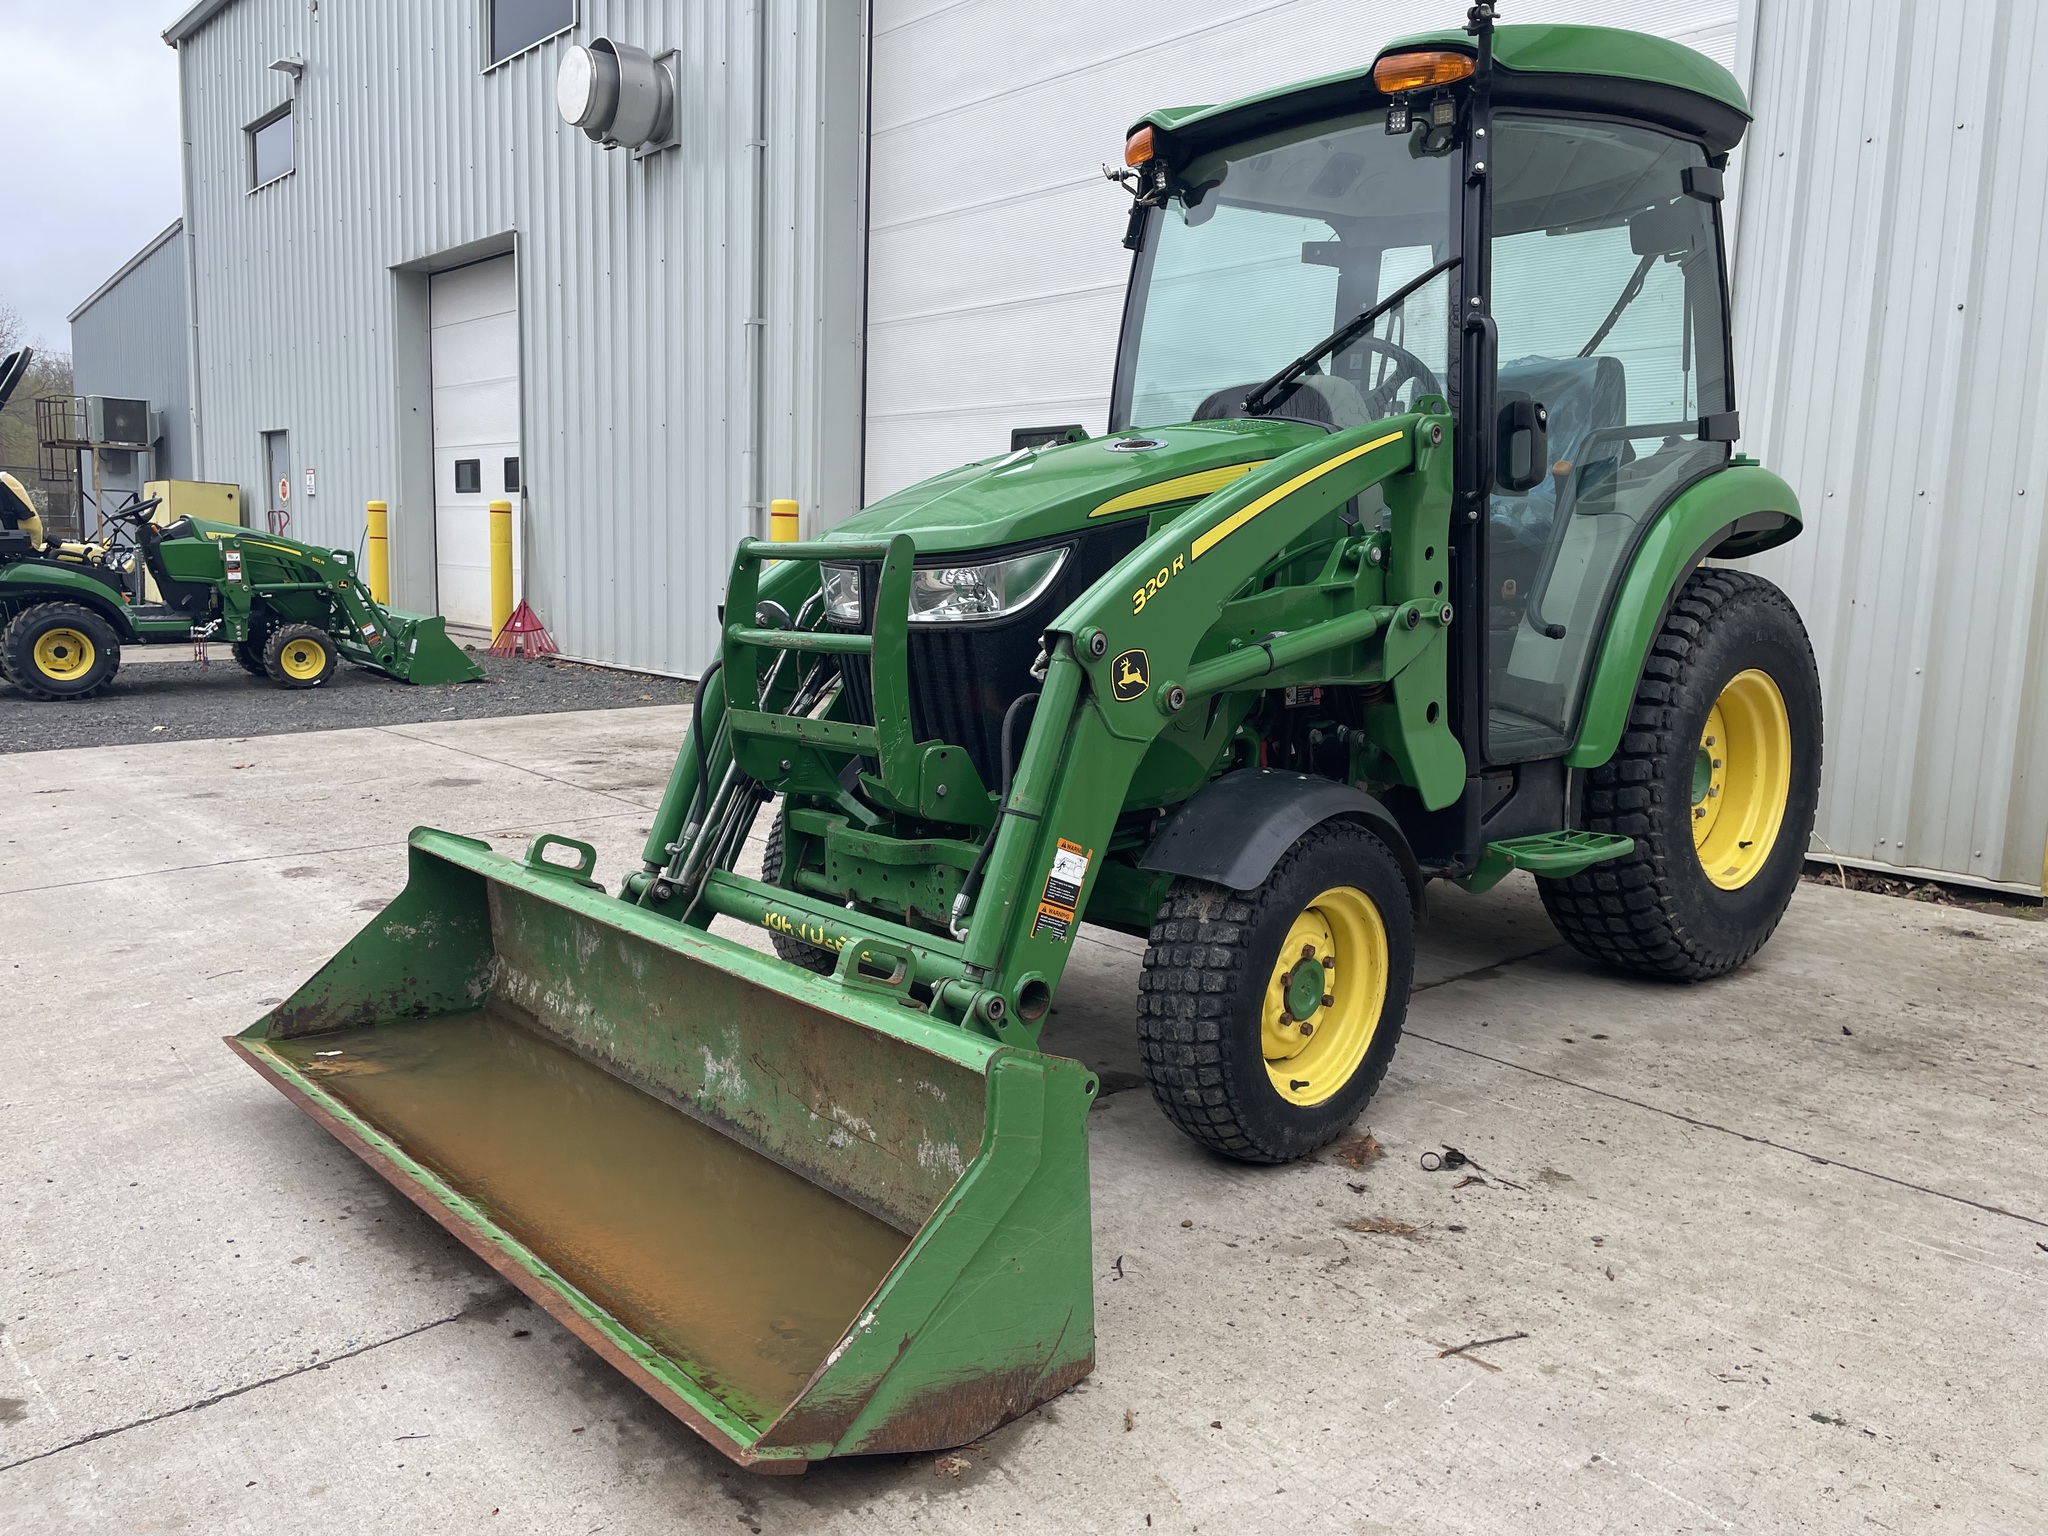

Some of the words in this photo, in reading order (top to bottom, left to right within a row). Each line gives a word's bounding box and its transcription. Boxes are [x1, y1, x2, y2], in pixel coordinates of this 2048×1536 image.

[1132, 566, 1169, 616] 320
[1172, 552, 1186, 578] R
[1067, 844, 1082, 854] WARN
[1048, 907, 1070, 920] WARNING
